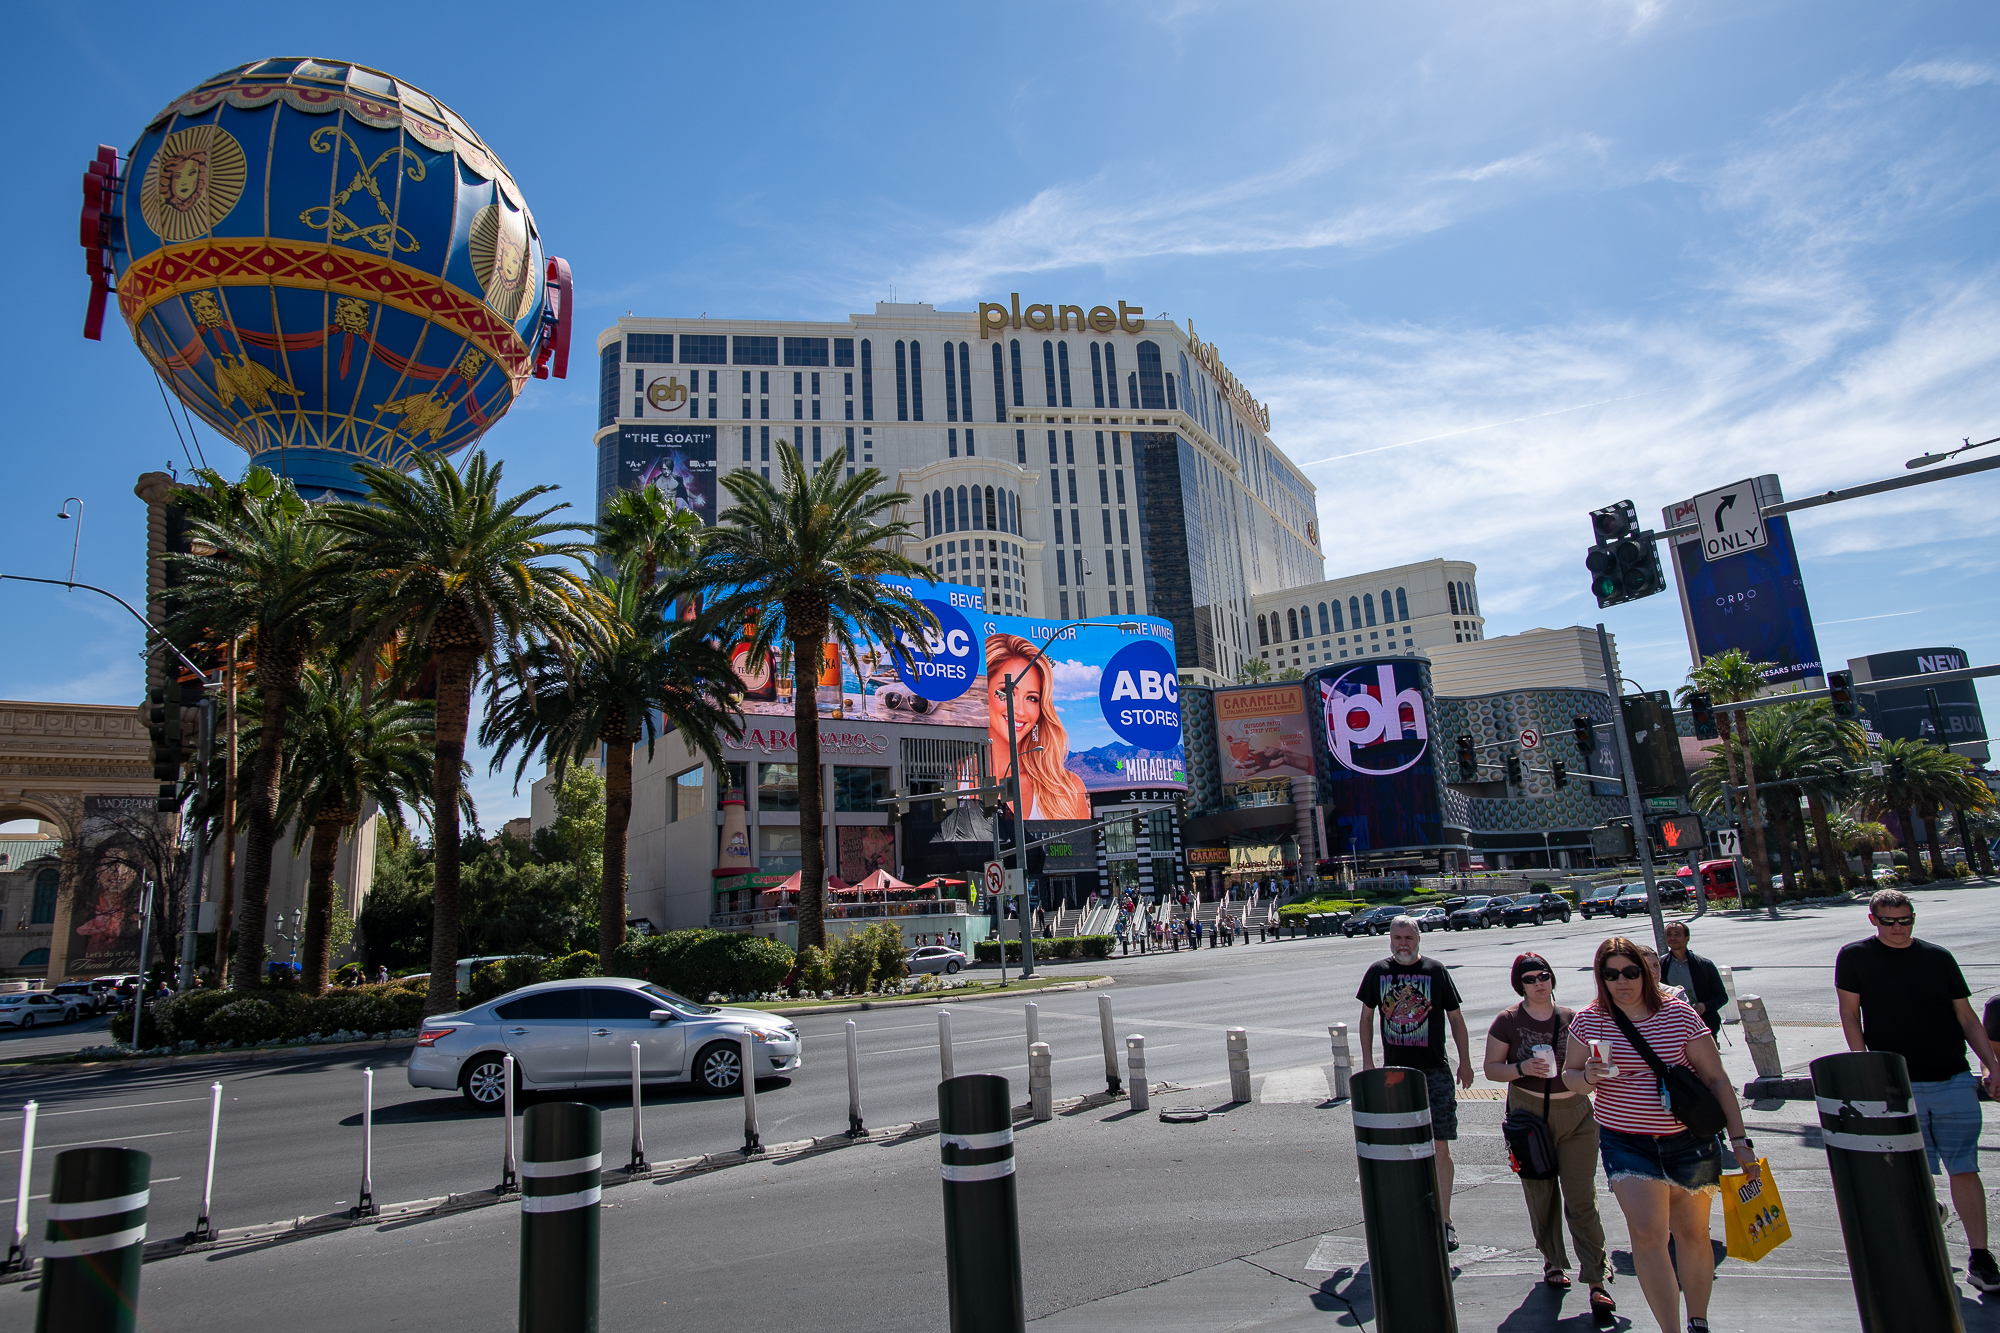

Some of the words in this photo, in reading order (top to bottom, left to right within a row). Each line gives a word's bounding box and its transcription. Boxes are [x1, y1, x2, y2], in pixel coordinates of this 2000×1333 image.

[979, 292, 1145, 340] planet
[1188, 317, 1271, 433] hollywood
[651, 376, 687, 406] ph
[1707, 526, 1759, 555] ONLY
[950, 591, 983, 610] BEVE
[900, 626, 970, 658] ABC
[1030, 625, 1077, 643] LIQUOR
[1149, 624, 1174, 642] WINES
[905, 661, 967, 680] STORES
[1917, 654, 1960, 673] NEW
[1110, 669, 1178, 704] ABC
[1223, 693, 1297, 709] CARAMELLA
[1119, 709, 1179, 729] STORES
[1330, 664, 1428, 768] ph
[819, 747, 866, 755] ANTINA
[1125, 758, 1174, 783] MIRACLE
[1049, 844, 1073, 857] SHOPS
[1237, 860, 1267, 871] planet
